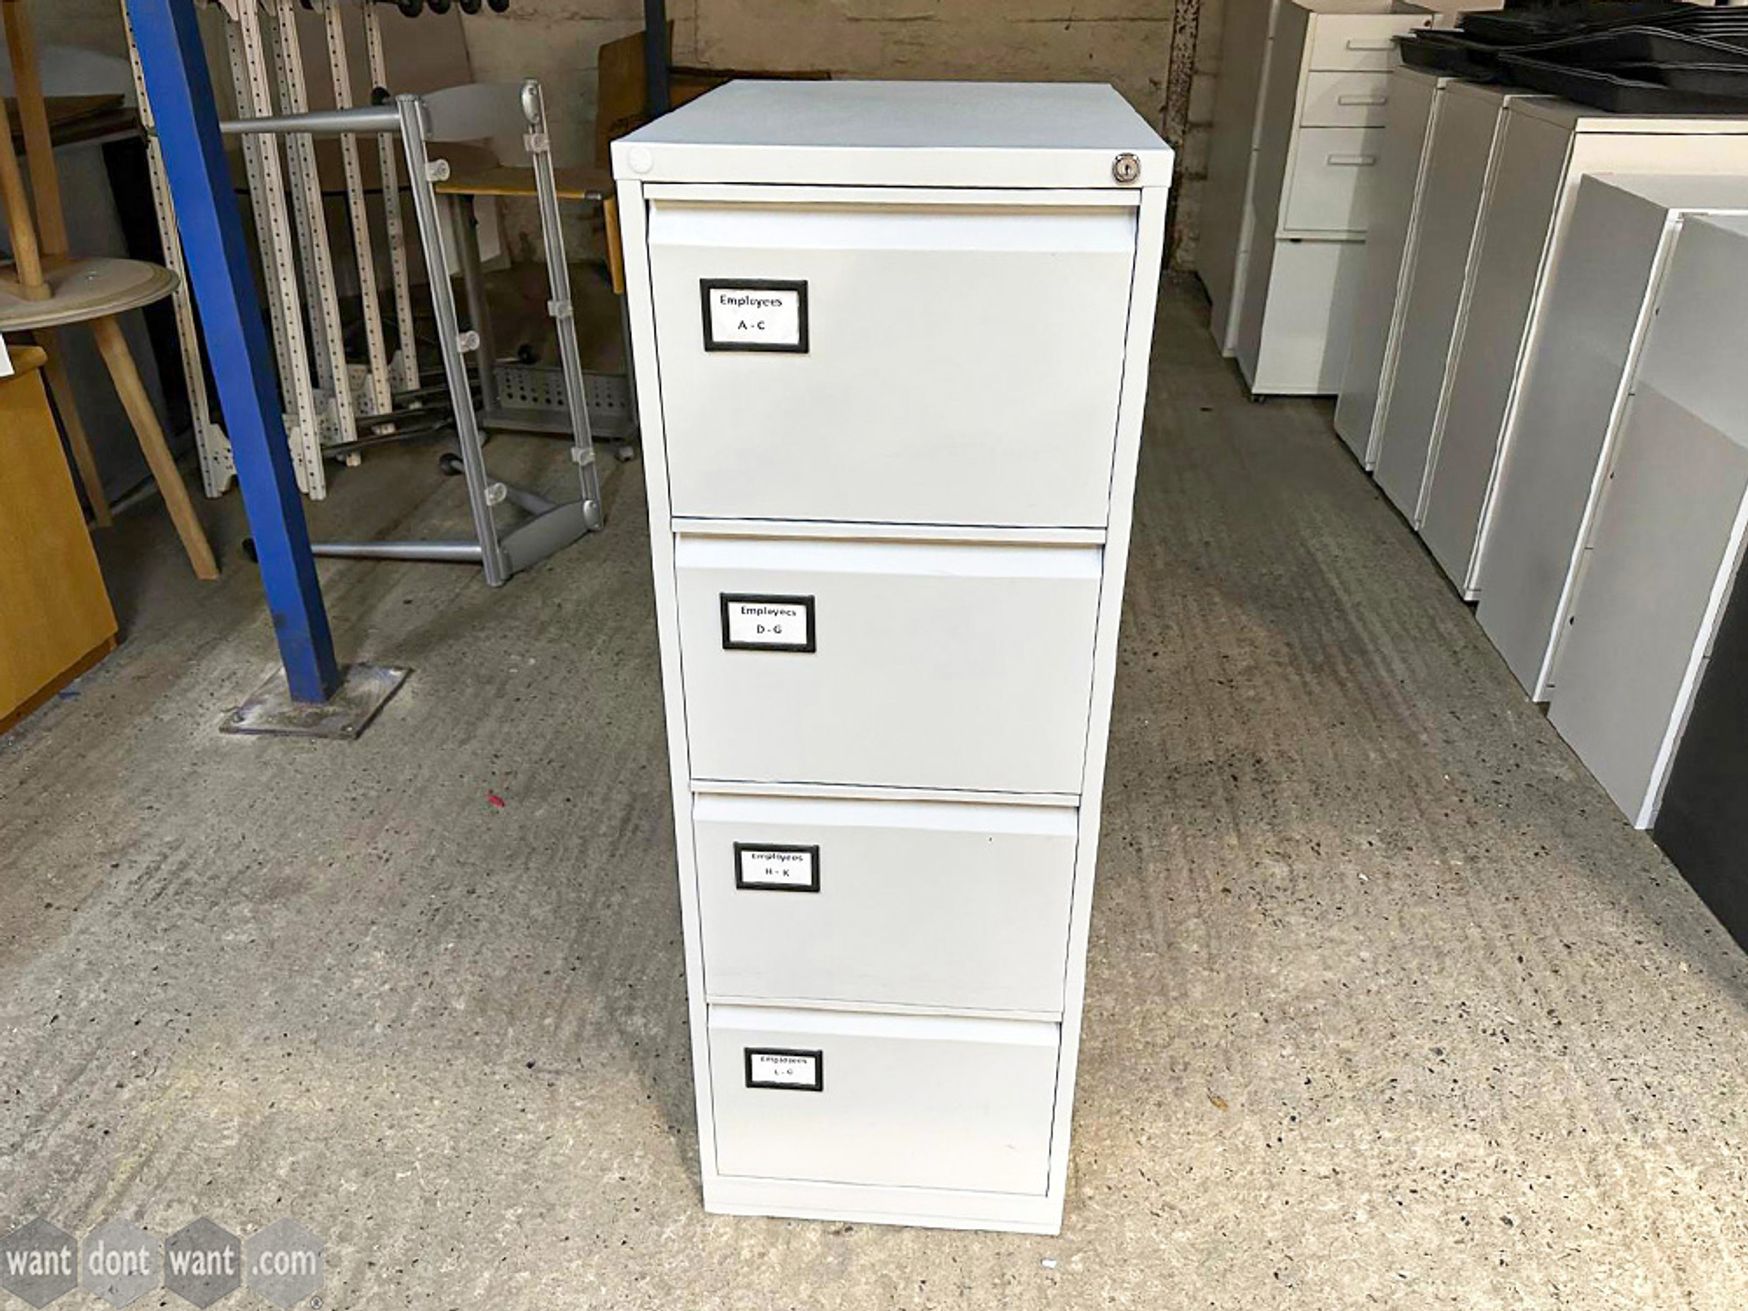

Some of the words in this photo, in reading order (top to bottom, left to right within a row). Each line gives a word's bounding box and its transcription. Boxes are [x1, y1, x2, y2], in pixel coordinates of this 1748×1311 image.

[720, 294, 782, 308] Employees
[738, 320, 747, 330] A
[757, 320, 765, 330] C
[741, 606, 796, 616] Employees
[757, 624, 765, 634] D
[773, 624, 782, 634] G
